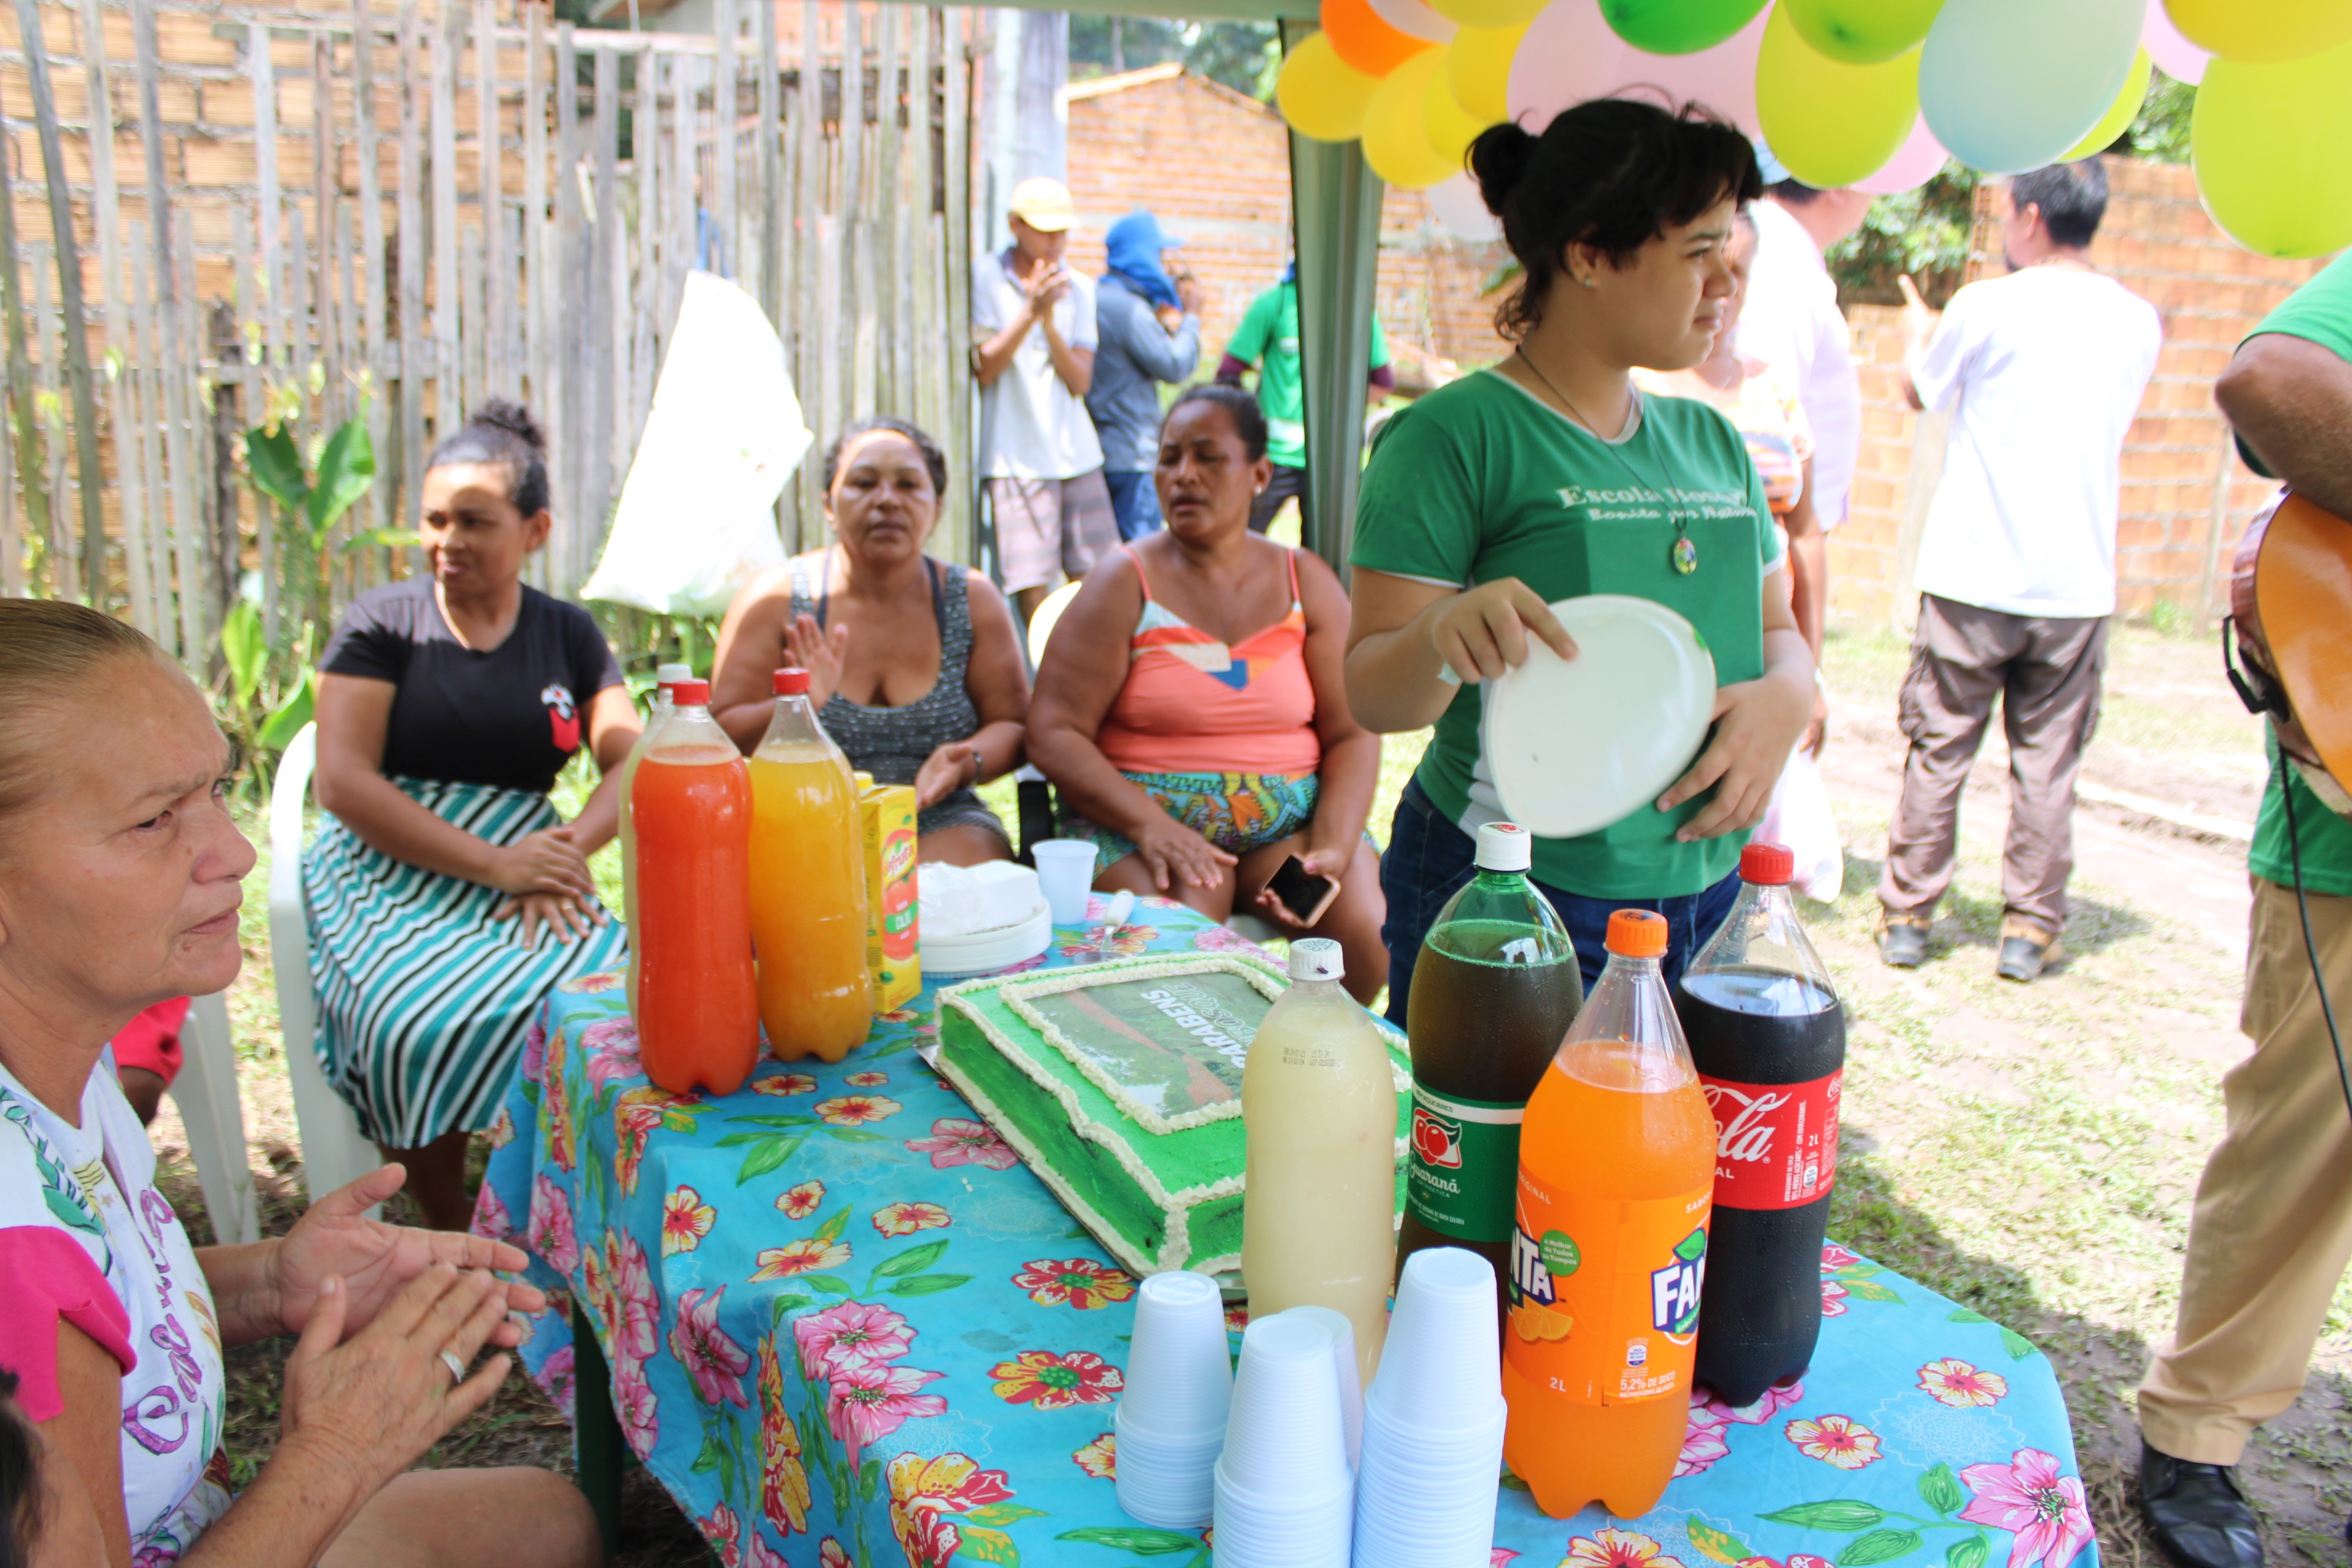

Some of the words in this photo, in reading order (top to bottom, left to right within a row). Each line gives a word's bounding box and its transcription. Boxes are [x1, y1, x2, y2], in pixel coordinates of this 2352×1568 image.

[1556, 485, 1665, 509] Escola
[896, 910, 912, 930] CAJU
[1162, 982, 1257, 1047] BOSQUE
[1409, 1150, 1461, 1194] Guaraná
[1550, 1240, 1572, 1249] Melhor
[1553, 1247, 1573, 1257] Todos
[1550, 1255, 1577, 1266] Tempos
[1620, 1377, 1647, 1393] 5,2%
[1648, 1377, 1658, 1388] DE
[1658, 1370, 1676, 1386] SUCO
